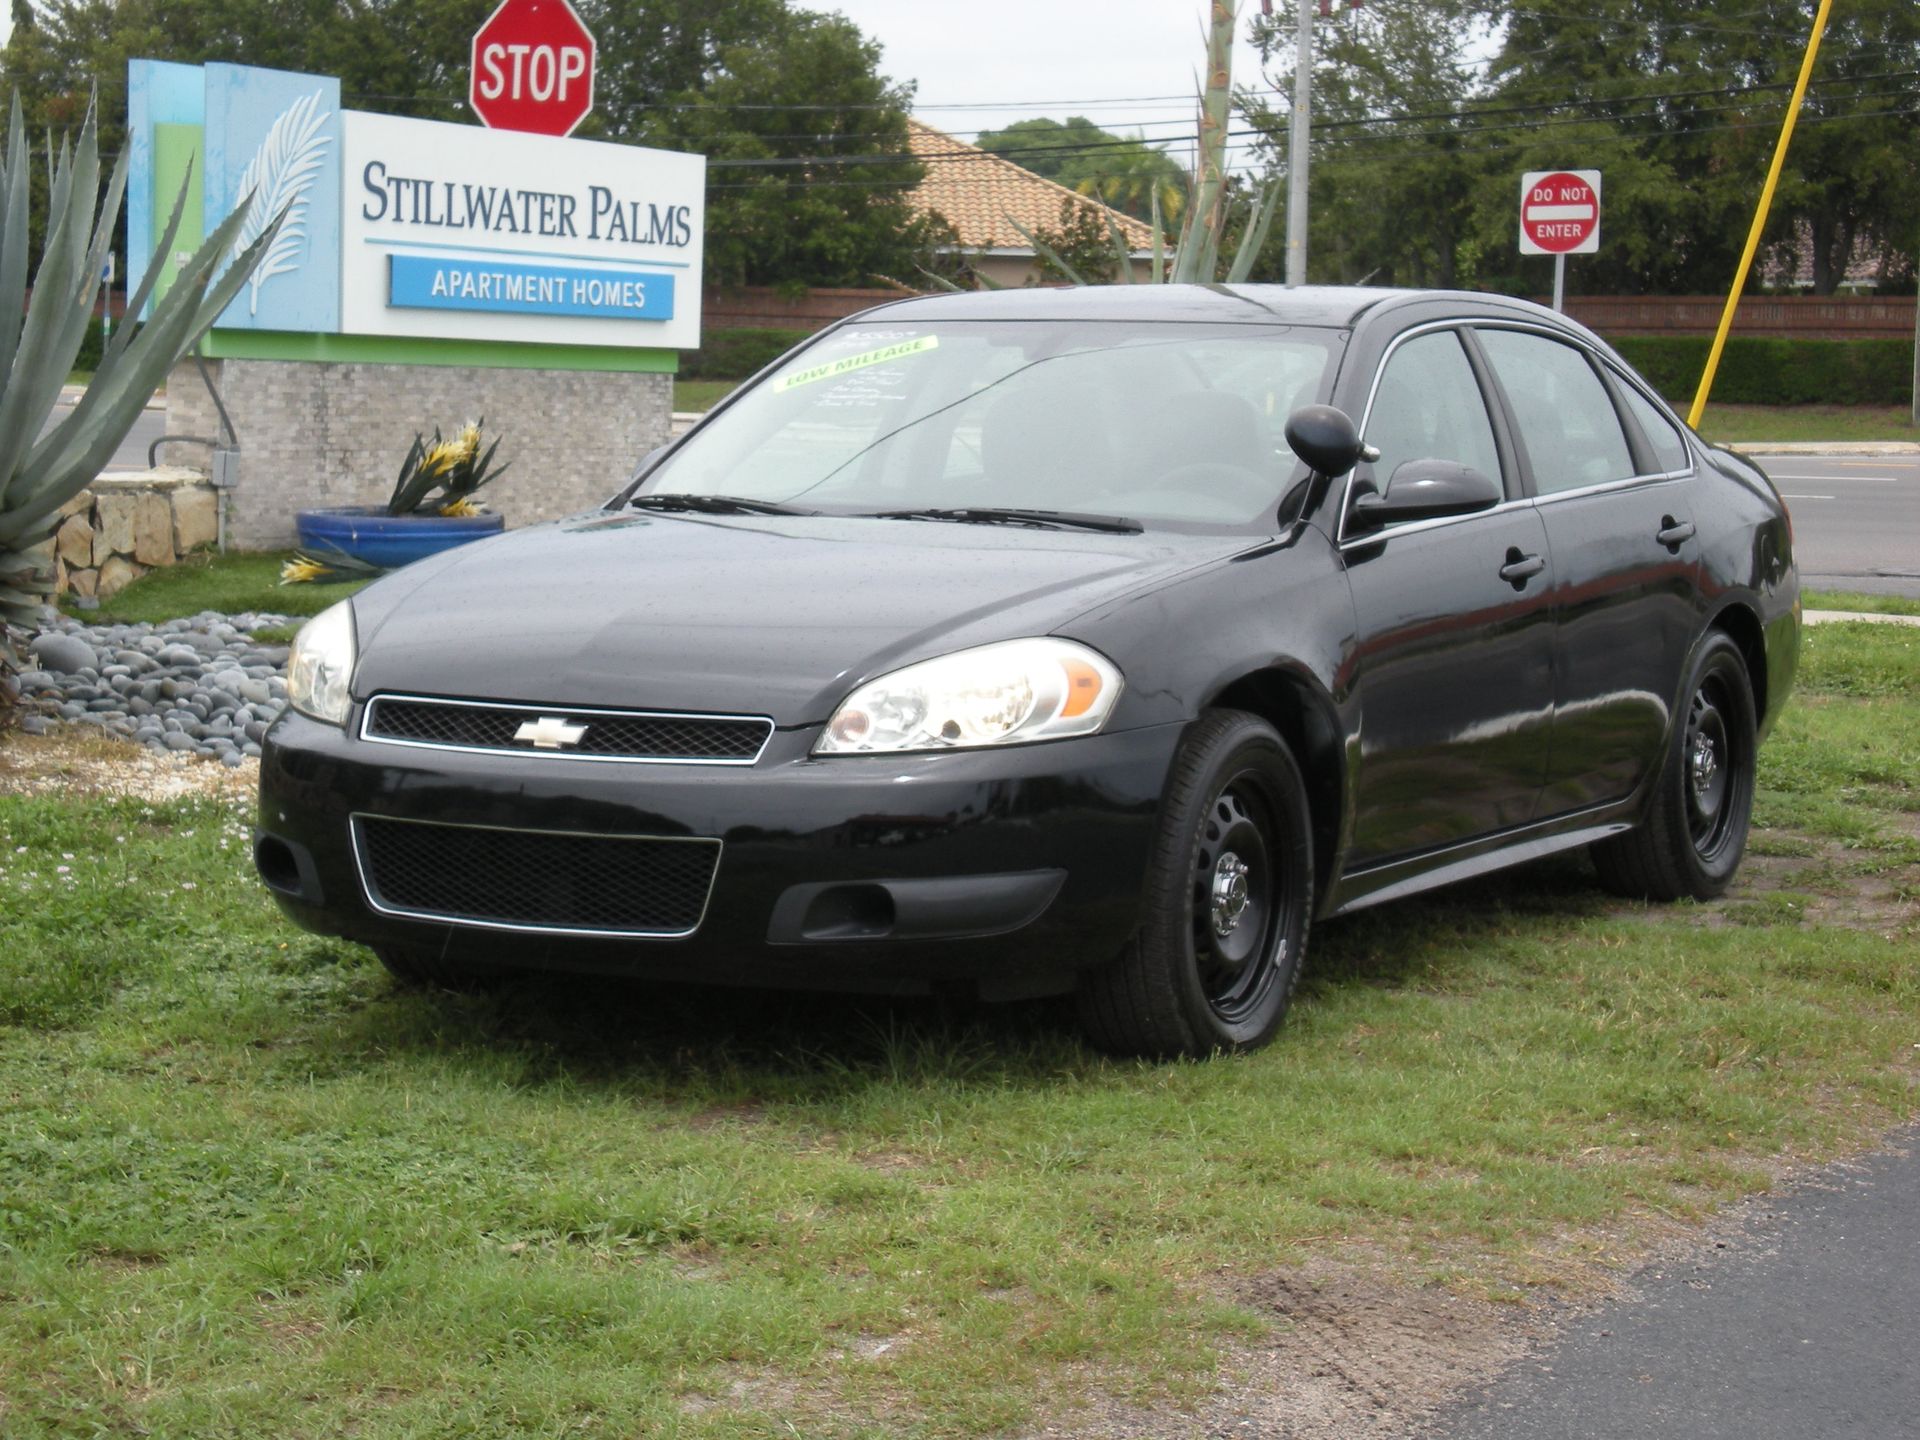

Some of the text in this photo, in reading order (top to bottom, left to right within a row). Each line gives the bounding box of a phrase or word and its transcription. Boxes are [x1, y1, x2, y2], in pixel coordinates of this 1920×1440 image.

[480, 43, 586, 102] STOP
[1533, 187, 1589, 202] DO NOT
[1537, 224, 1582, 238] ENTER
[431, 269, 646, 309] APARTMENT HOMES
[786, 341, 923, 386] LOW MILEAGE
